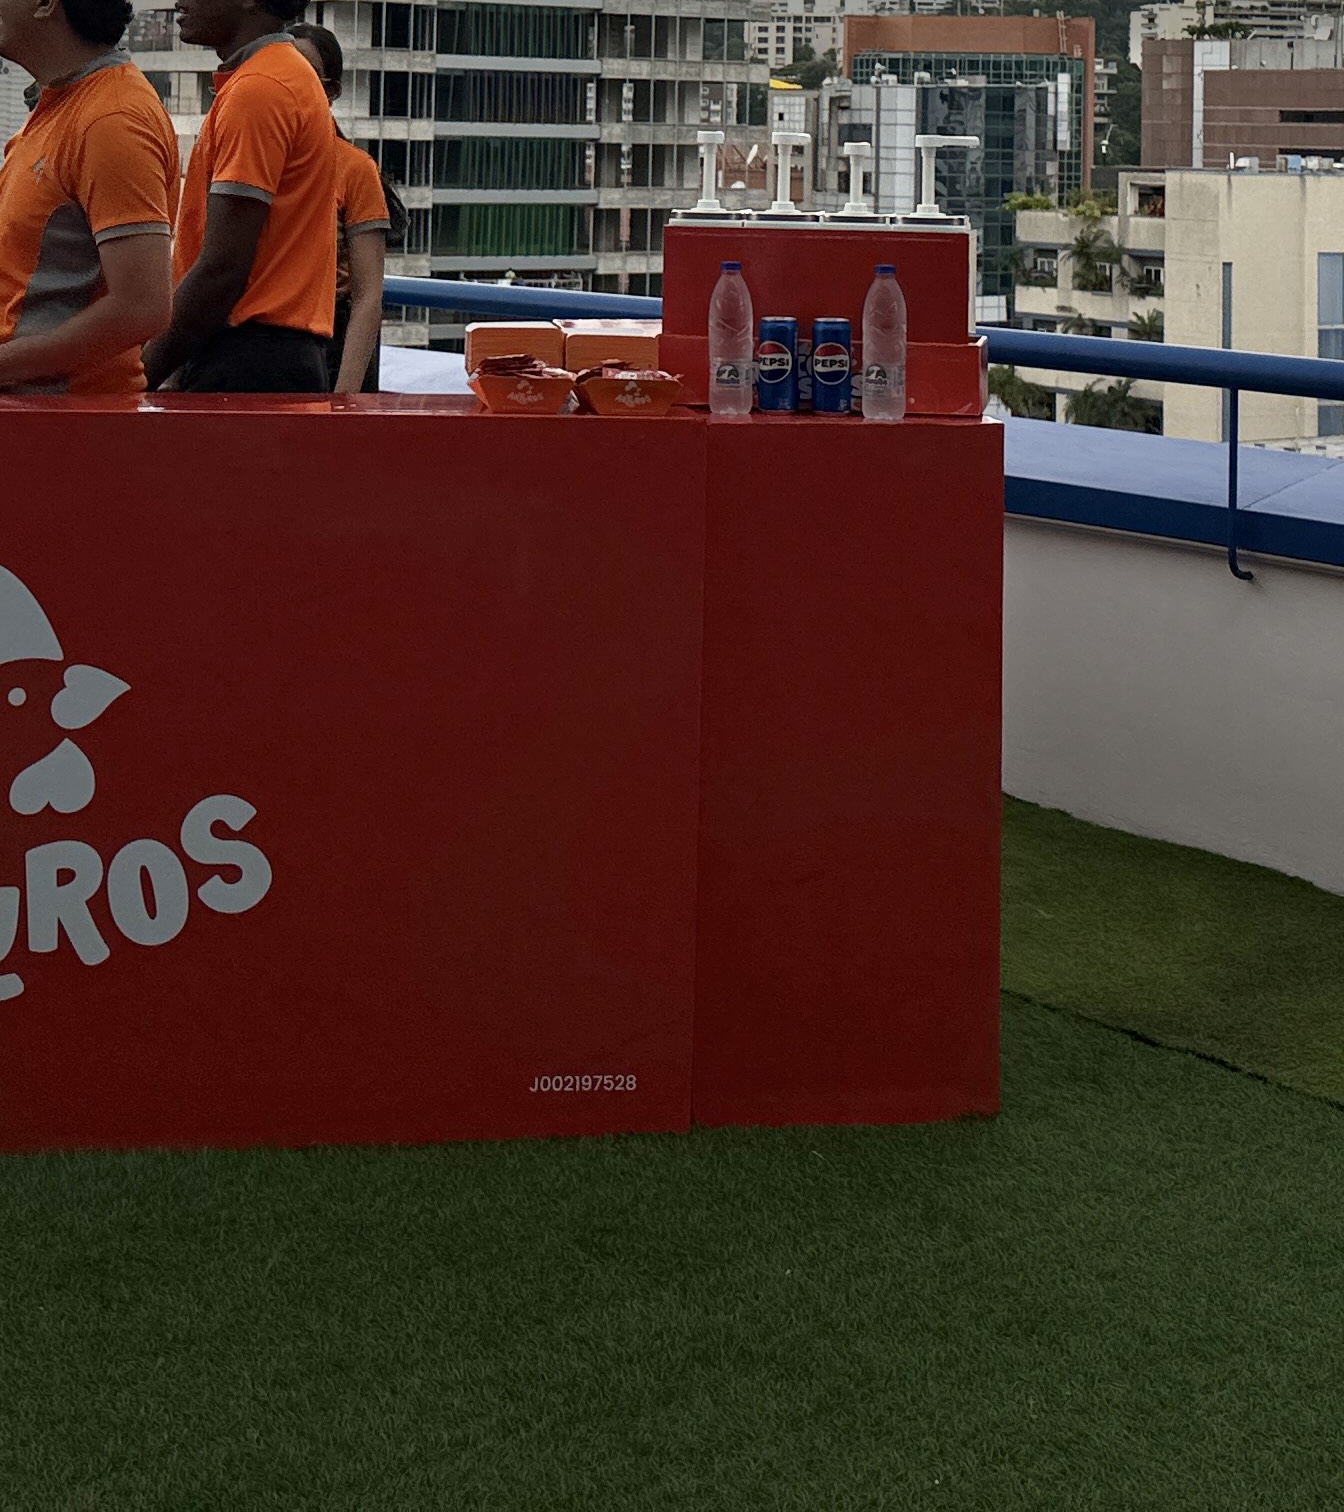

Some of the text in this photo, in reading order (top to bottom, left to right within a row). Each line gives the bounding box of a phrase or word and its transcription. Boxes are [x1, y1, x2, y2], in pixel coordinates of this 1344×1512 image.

[758, 356, 790, 367] PEPSI
[814, 358, 848, 369] PEPSI
[528, 1074, 637, 1093] J002197528
